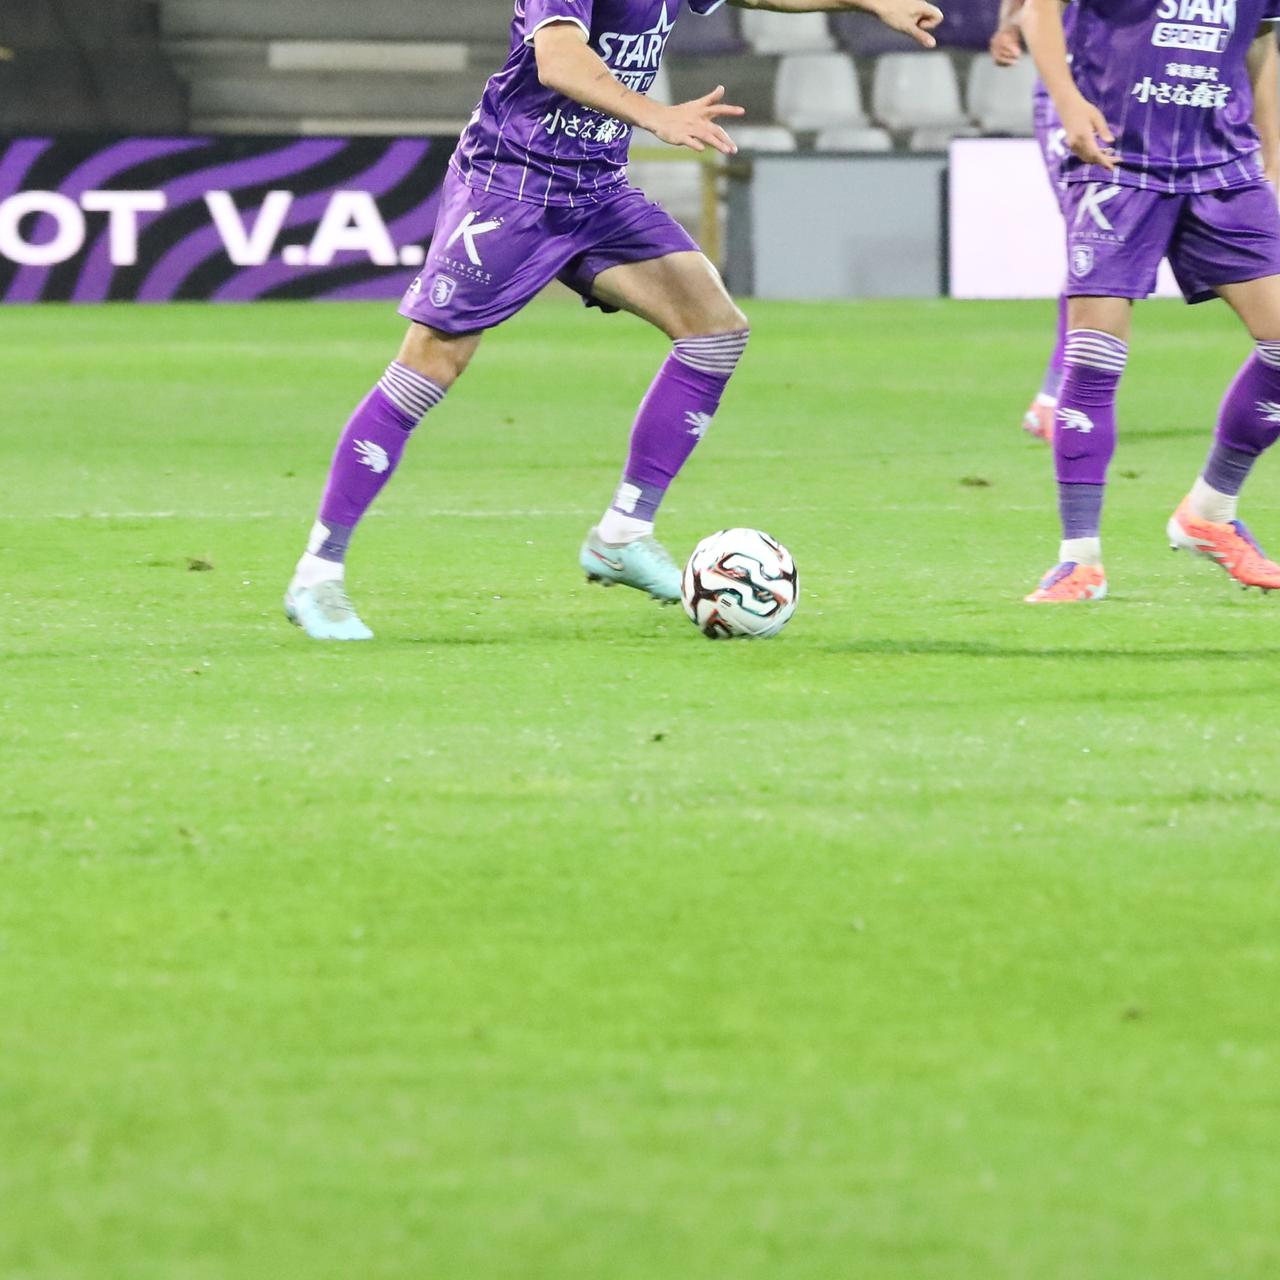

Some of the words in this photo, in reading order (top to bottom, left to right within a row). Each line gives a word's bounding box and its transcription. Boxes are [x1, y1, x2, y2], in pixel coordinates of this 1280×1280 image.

[598, 32, 664, 69] STAR
[1158, 27, 1216, 47] SPORT
[204, 190, 424, 266] V.A.
